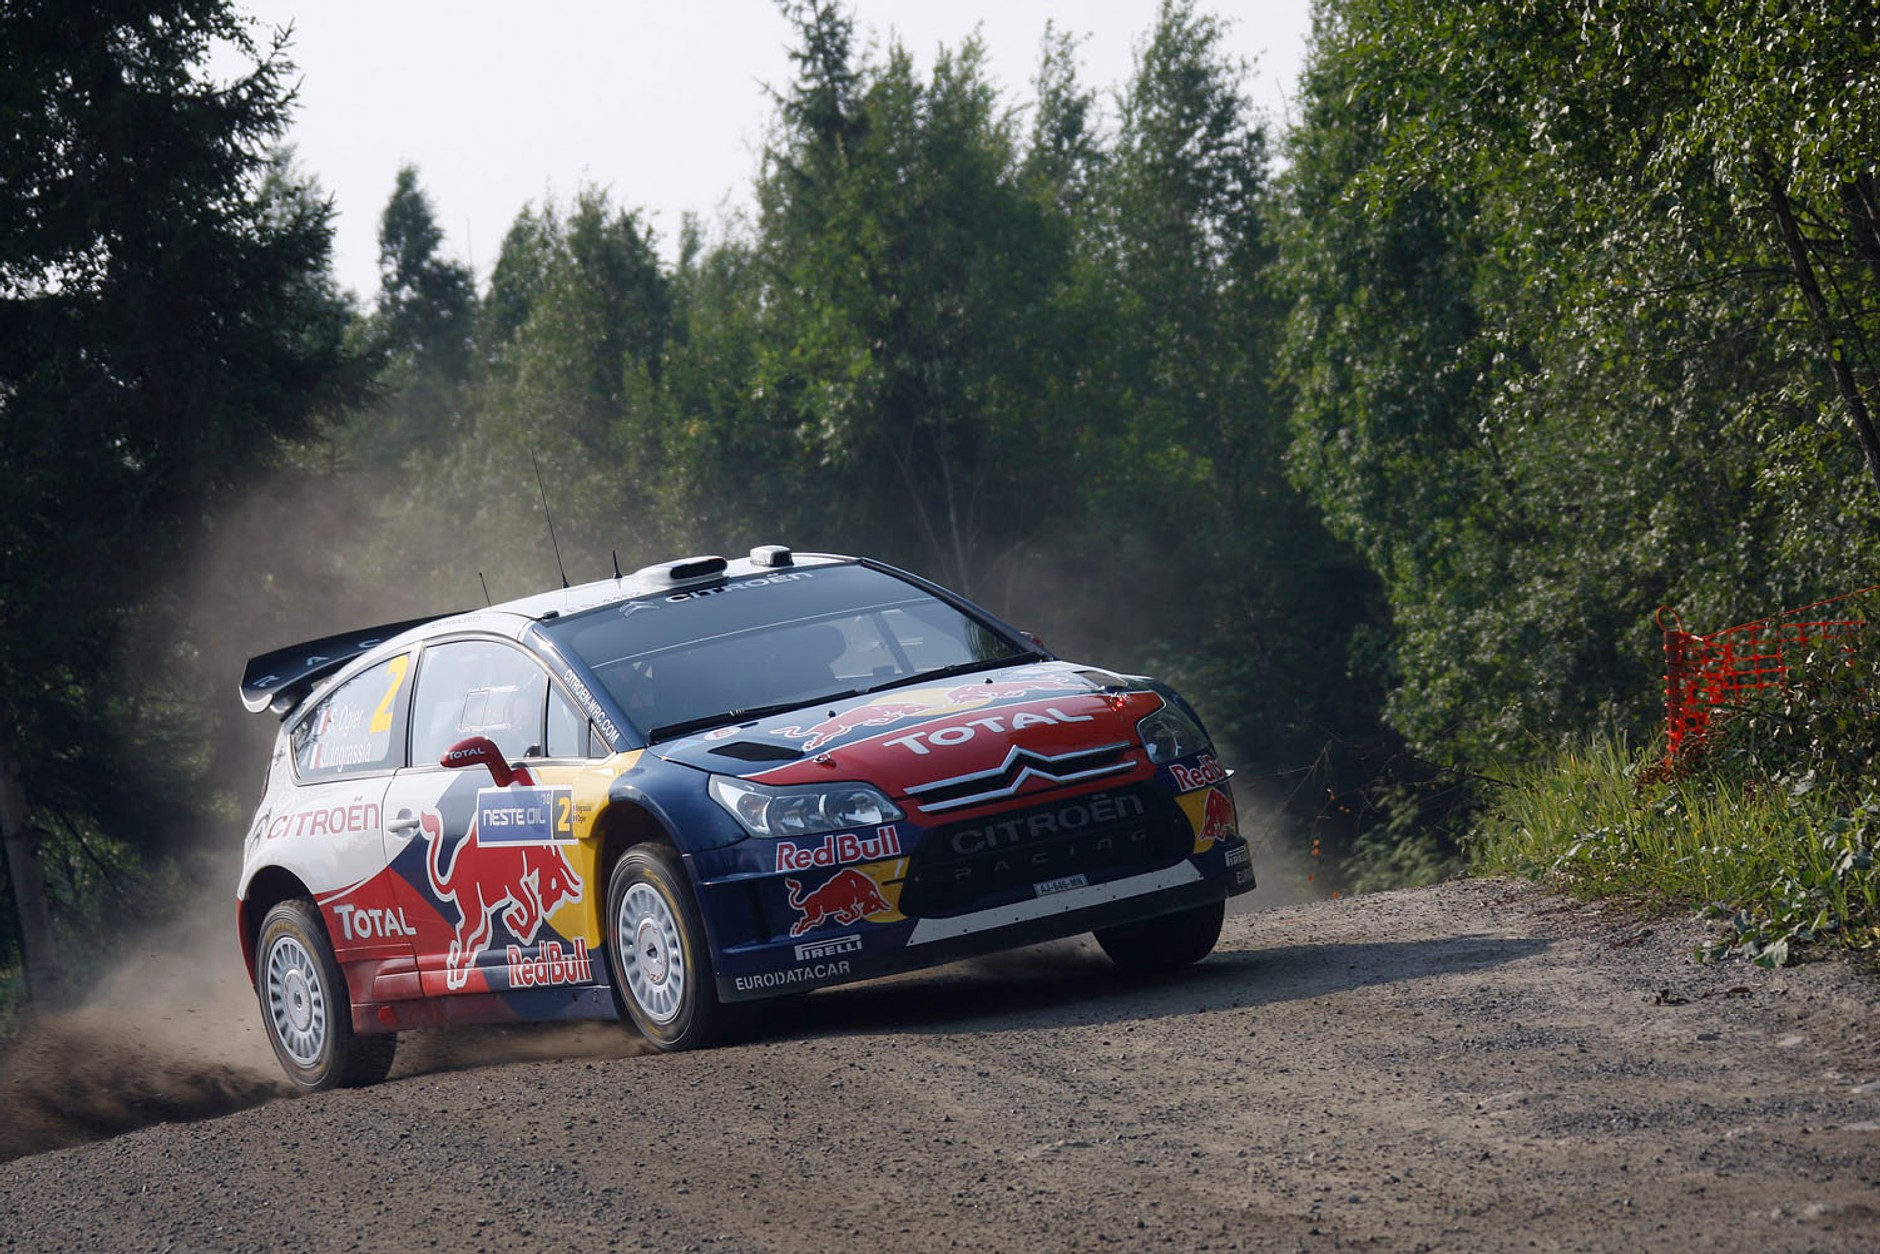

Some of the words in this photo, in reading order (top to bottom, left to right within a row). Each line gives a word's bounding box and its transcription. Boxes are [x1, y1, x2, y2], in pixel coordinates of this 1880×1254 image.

[665, 571, 814, 604] CITROËN
[369, 655, 410, 733] 2
[564, 669, 621, 745] CITROEN-WRC.COM
[882, 706, 1094, 755] TOTAL
[447, 746, 487, 761] TOTAL
[1169, 754, 1213, 792] Red
[267, 796, 381, 840] CITROËN
[483, 806, 526, 827] NESTE
[526, 806, 547, 825] OIL
[557, 797, 571, 832] 2
[952, 793, 1145, 855] CITROËN
[775, 834, 836, 872] Red
[837, 825, 902, 864] Bull
[334, 903, 417, 941] TOTAL
[506, 940, 550, 988] Red
[549, 935, 593, 984] Bull
[794, 934, 864, 962] PIRELLI
[735, 960, 851, 992] EURODATACAR
